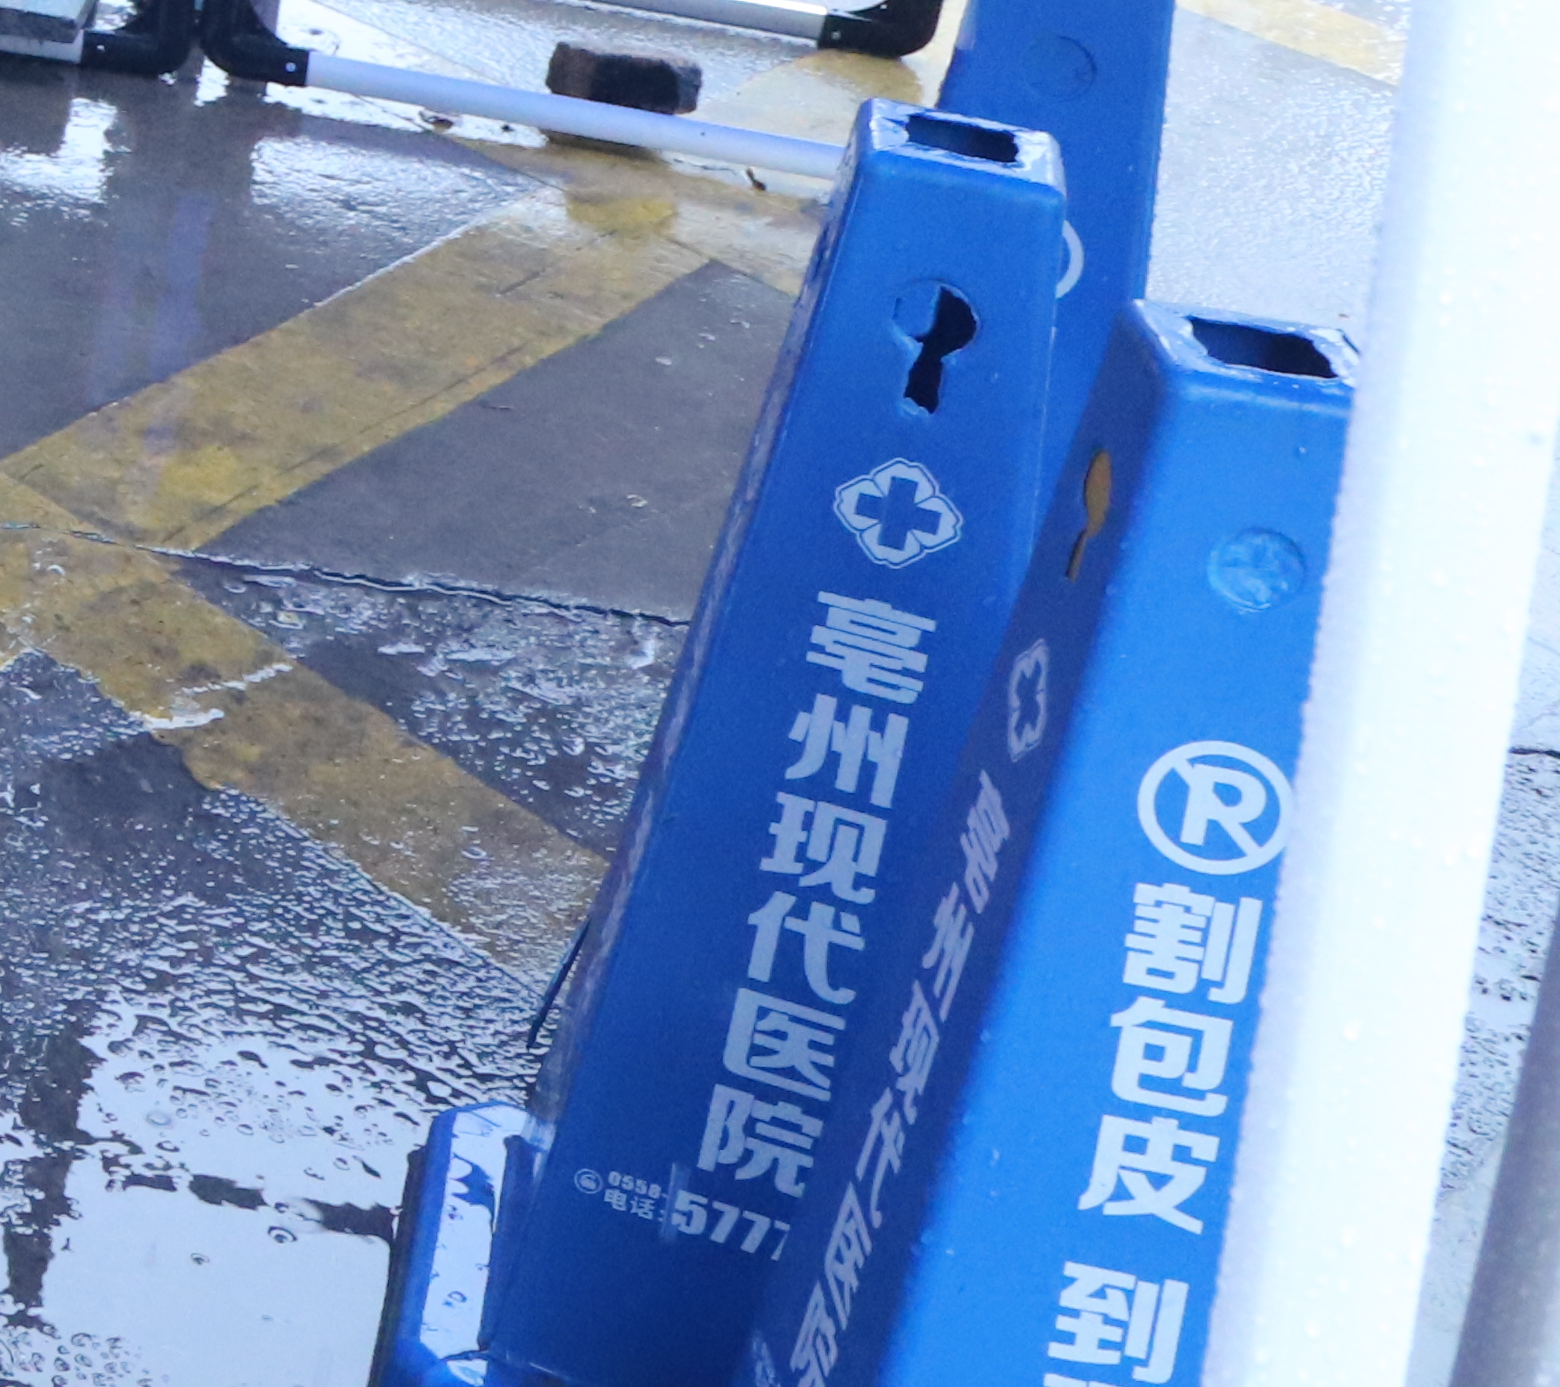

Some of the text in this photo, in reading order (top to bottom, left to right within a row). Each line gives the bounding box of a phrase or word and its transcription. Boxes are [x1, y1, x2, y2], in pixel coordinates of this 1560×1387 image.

[1076, 881, 1266, 1237] 割包皮
[1043, 1259, 1191, 1387] 到
